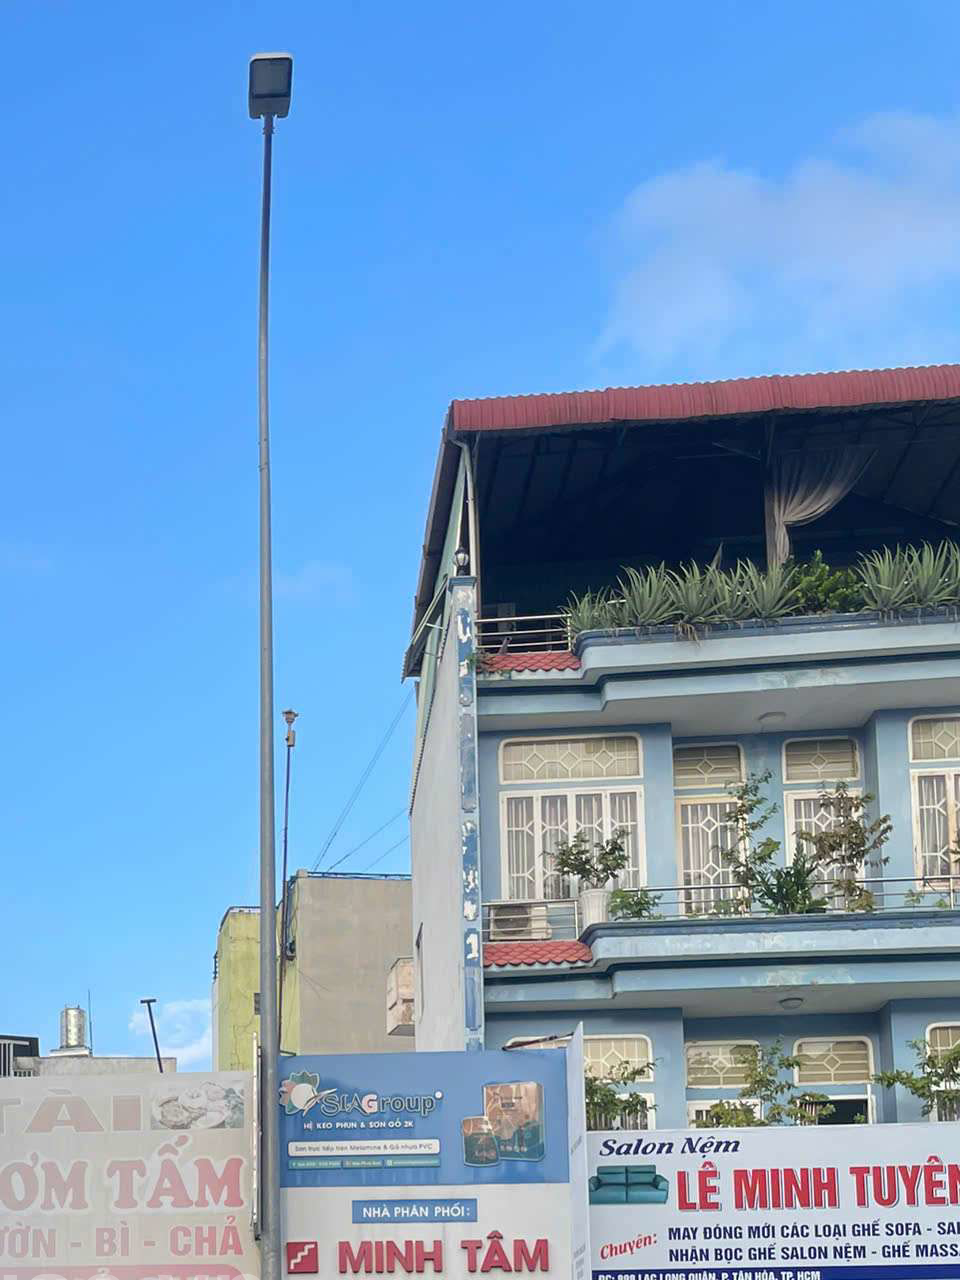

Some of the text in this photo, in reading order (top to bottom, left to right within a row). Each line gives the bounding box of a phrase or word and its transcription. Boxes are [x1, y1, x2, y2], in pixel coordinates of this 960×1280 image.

[336, 1121, 358, 1129] PHUN
[599, 1138, 674, 1156] Salon
[680, 1135, 741, 1158] Nệm
[106, 1134, 245, 1209] TẤM
[677, 1160, 722, 1212] LÊ
[733, 1167, 840, 1210] MINH
[363, 1203, 390, 1218] NHÀ
[394, 1203, 428, 1217] PHÂN
[95, 1221, 130, 1257] BÌ
[169, 1215, 244, 1256] CHẢ
[668, 1227, 698, 1240] MAY
[703, 1224, 743, 1239] ĐÓNG
[748, 1222, 775, 1238] MỚI
[780, 1222, 809, 1238] CÁC
[814, 1223, 846, 1241] LOẠI
[852, 1218, 880, 1237] GHẾ
[885, 1222, 922, 1236] SOFA
[338, 1230, 550, 1274] MINH TÂM
[669, 1240, 960, 1264] NHẬN BỌC GHẾ SALON NỆM GHẾ MASS
[780, 1271, 795, 1280] TP.
[797, 1270, 821, 1280] HCM
